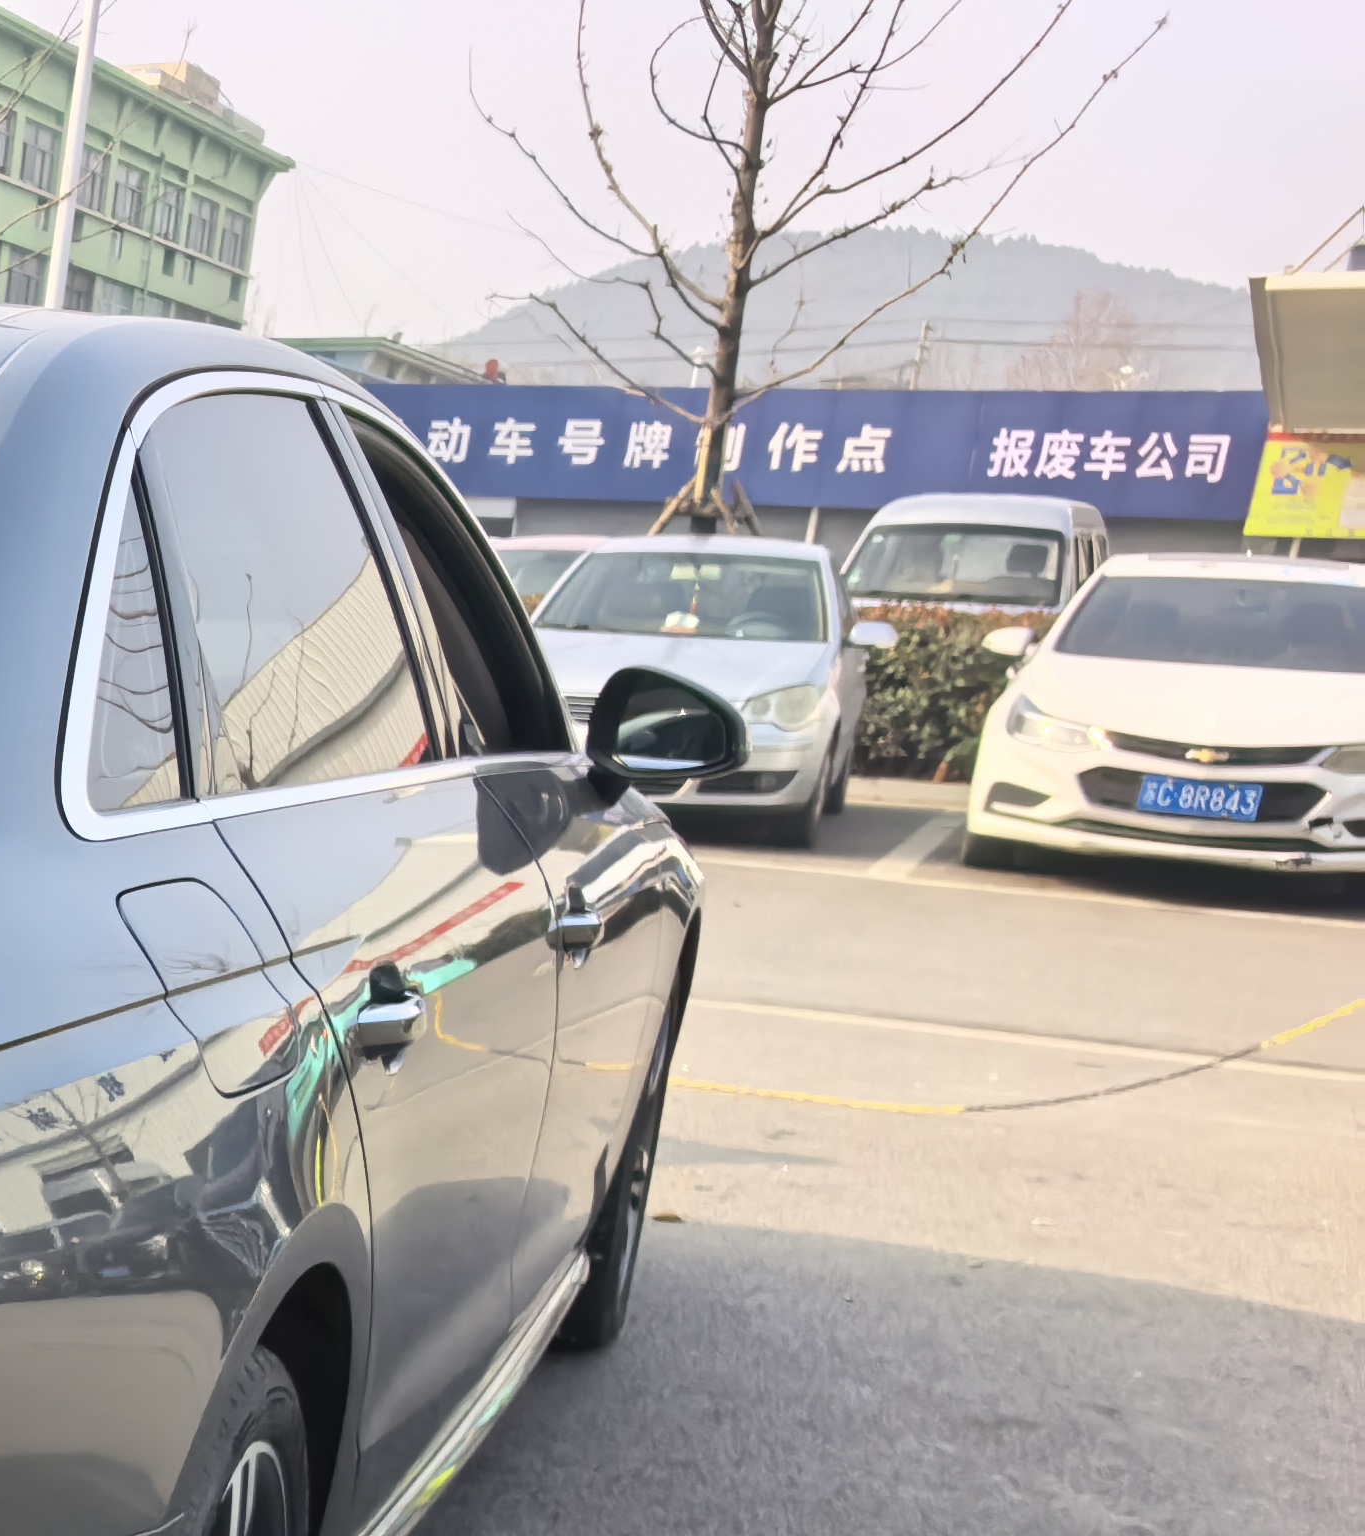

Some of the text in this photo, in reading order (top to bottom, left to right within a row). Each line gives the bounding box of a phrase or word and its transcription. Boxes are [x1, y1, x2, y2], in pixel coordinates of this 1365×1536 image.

[986, 427, 1232, 484] 报废车公司
